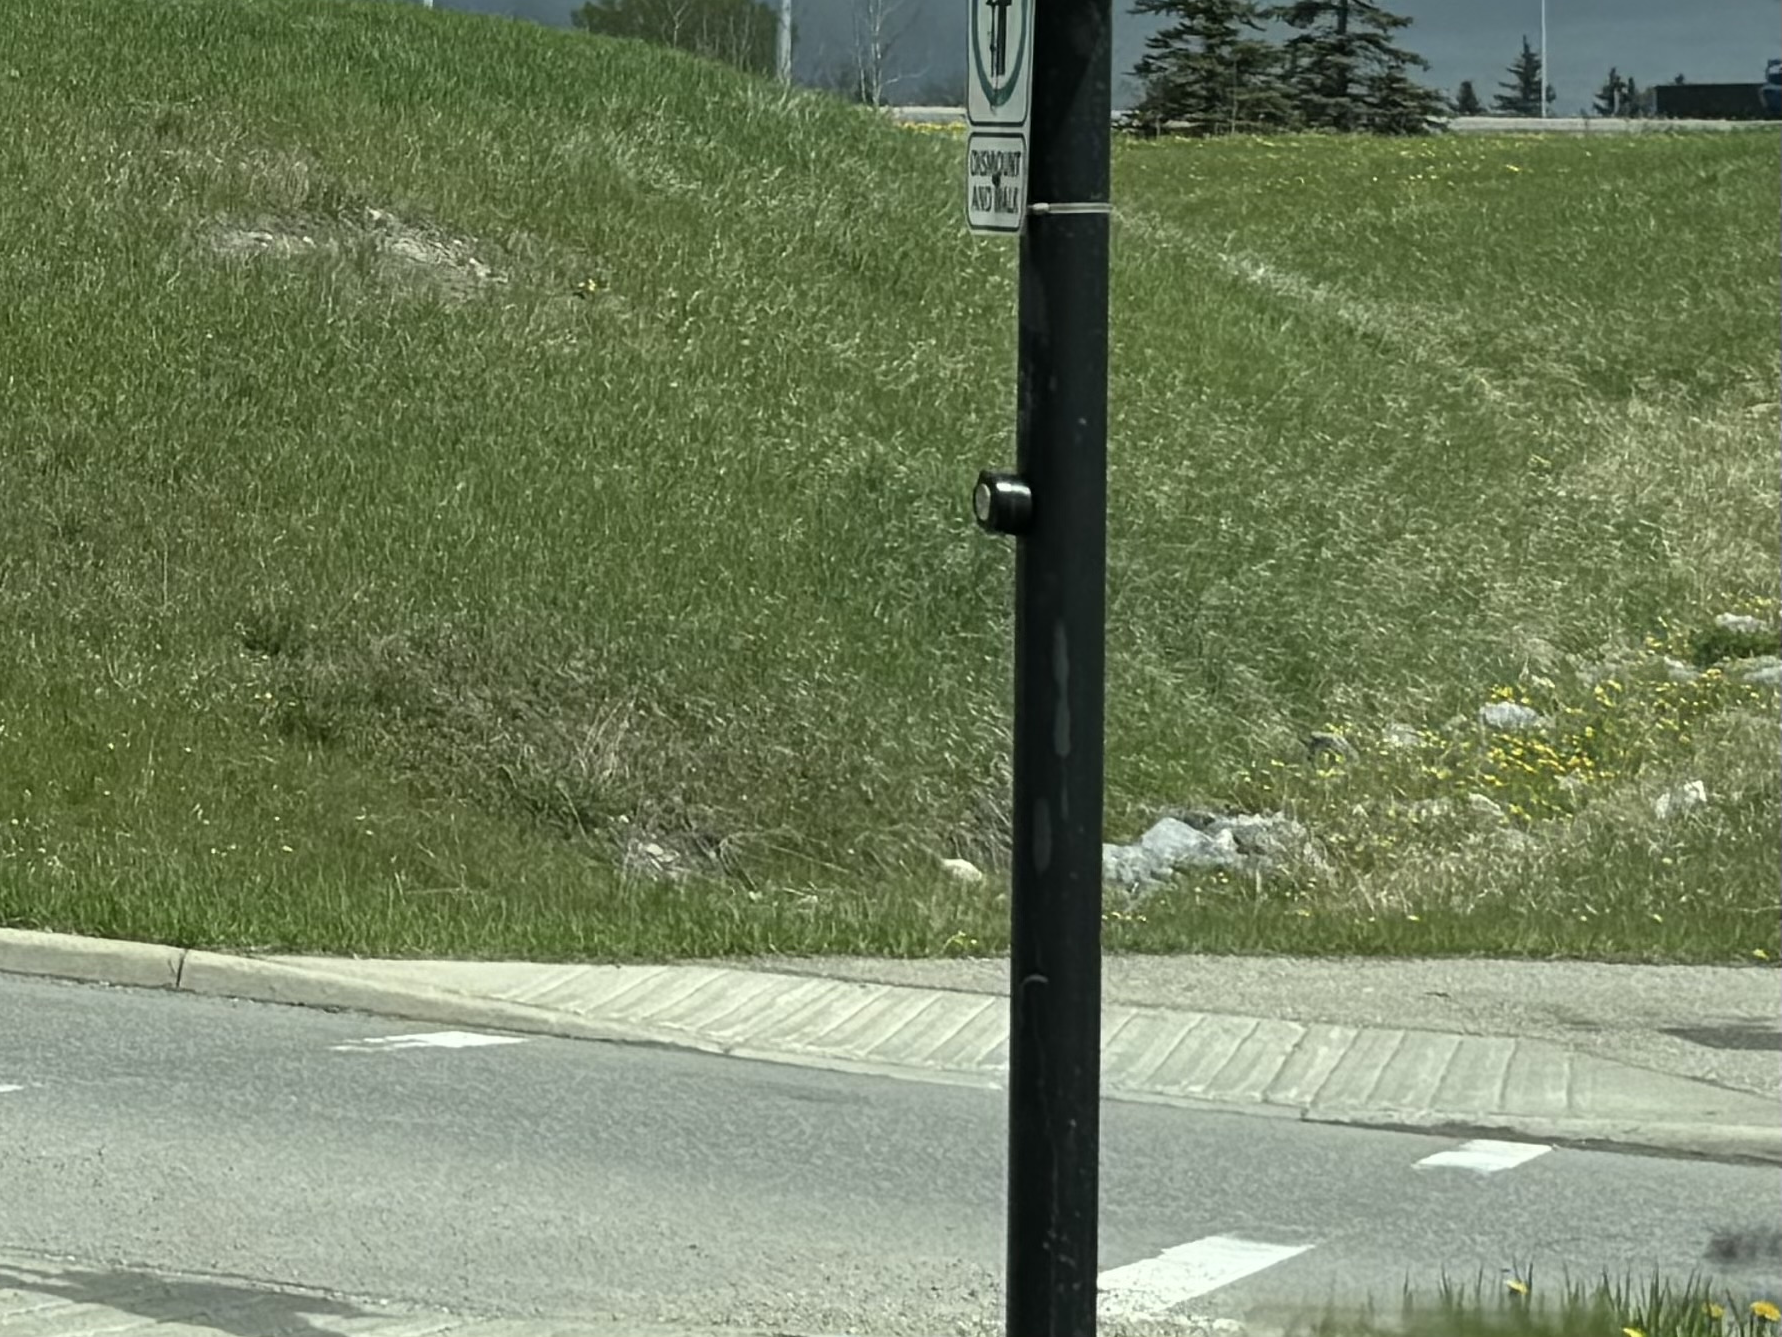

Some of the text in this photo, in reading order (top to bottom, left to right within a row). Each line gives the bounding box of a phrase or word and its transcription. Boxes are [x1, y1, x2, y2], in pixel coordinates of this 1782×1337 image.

[970, 150, 1021, 177] DISMOUNT
[971, 185, 1019, 214] AND WALK
